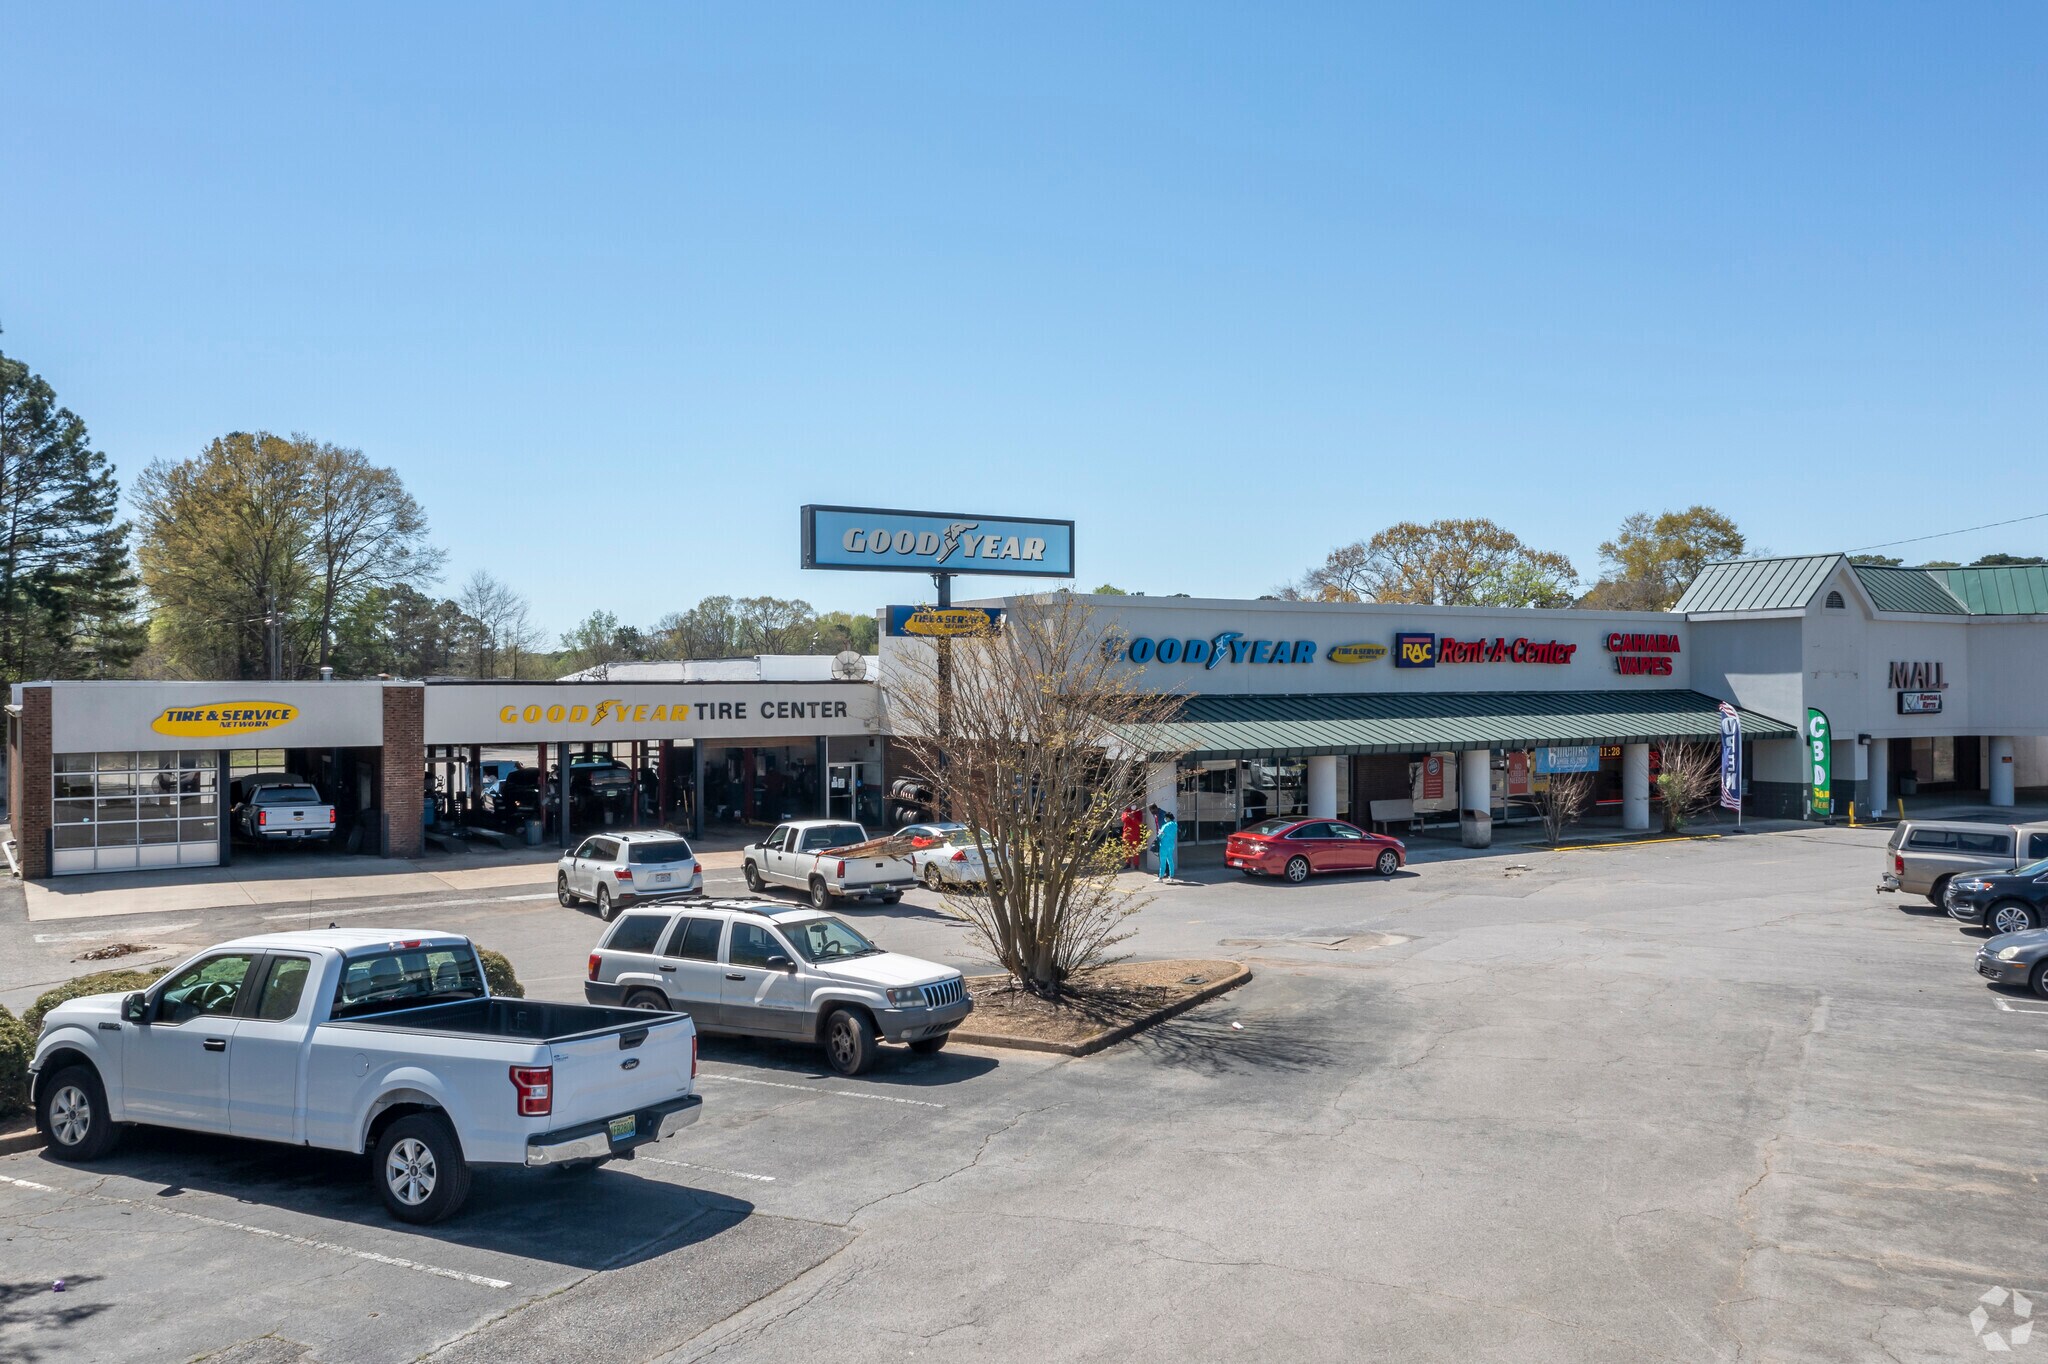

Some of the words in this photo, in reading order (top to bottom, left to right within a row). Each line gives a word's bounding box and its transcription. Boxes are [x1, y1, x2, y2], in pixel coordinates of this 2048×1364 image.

[1607, 633, 1681, 652] CAHABA
[1402, 643, 1432, 664] RAC
[1616, 656, 1673, 675] VAPES
[1888, 661, 1949, 689] MALL
[167, 711, 204, 722] TIRE
[206, 711, 219, 721] &
[221, 709, 291, 721] SERVICE
[694, 702, 747, 720] TIRE
[760, 701, 848, 719] CENTER
[1600, 747, 1620, 757] 11:28
[1810, 716, 1826, 785] CBD
